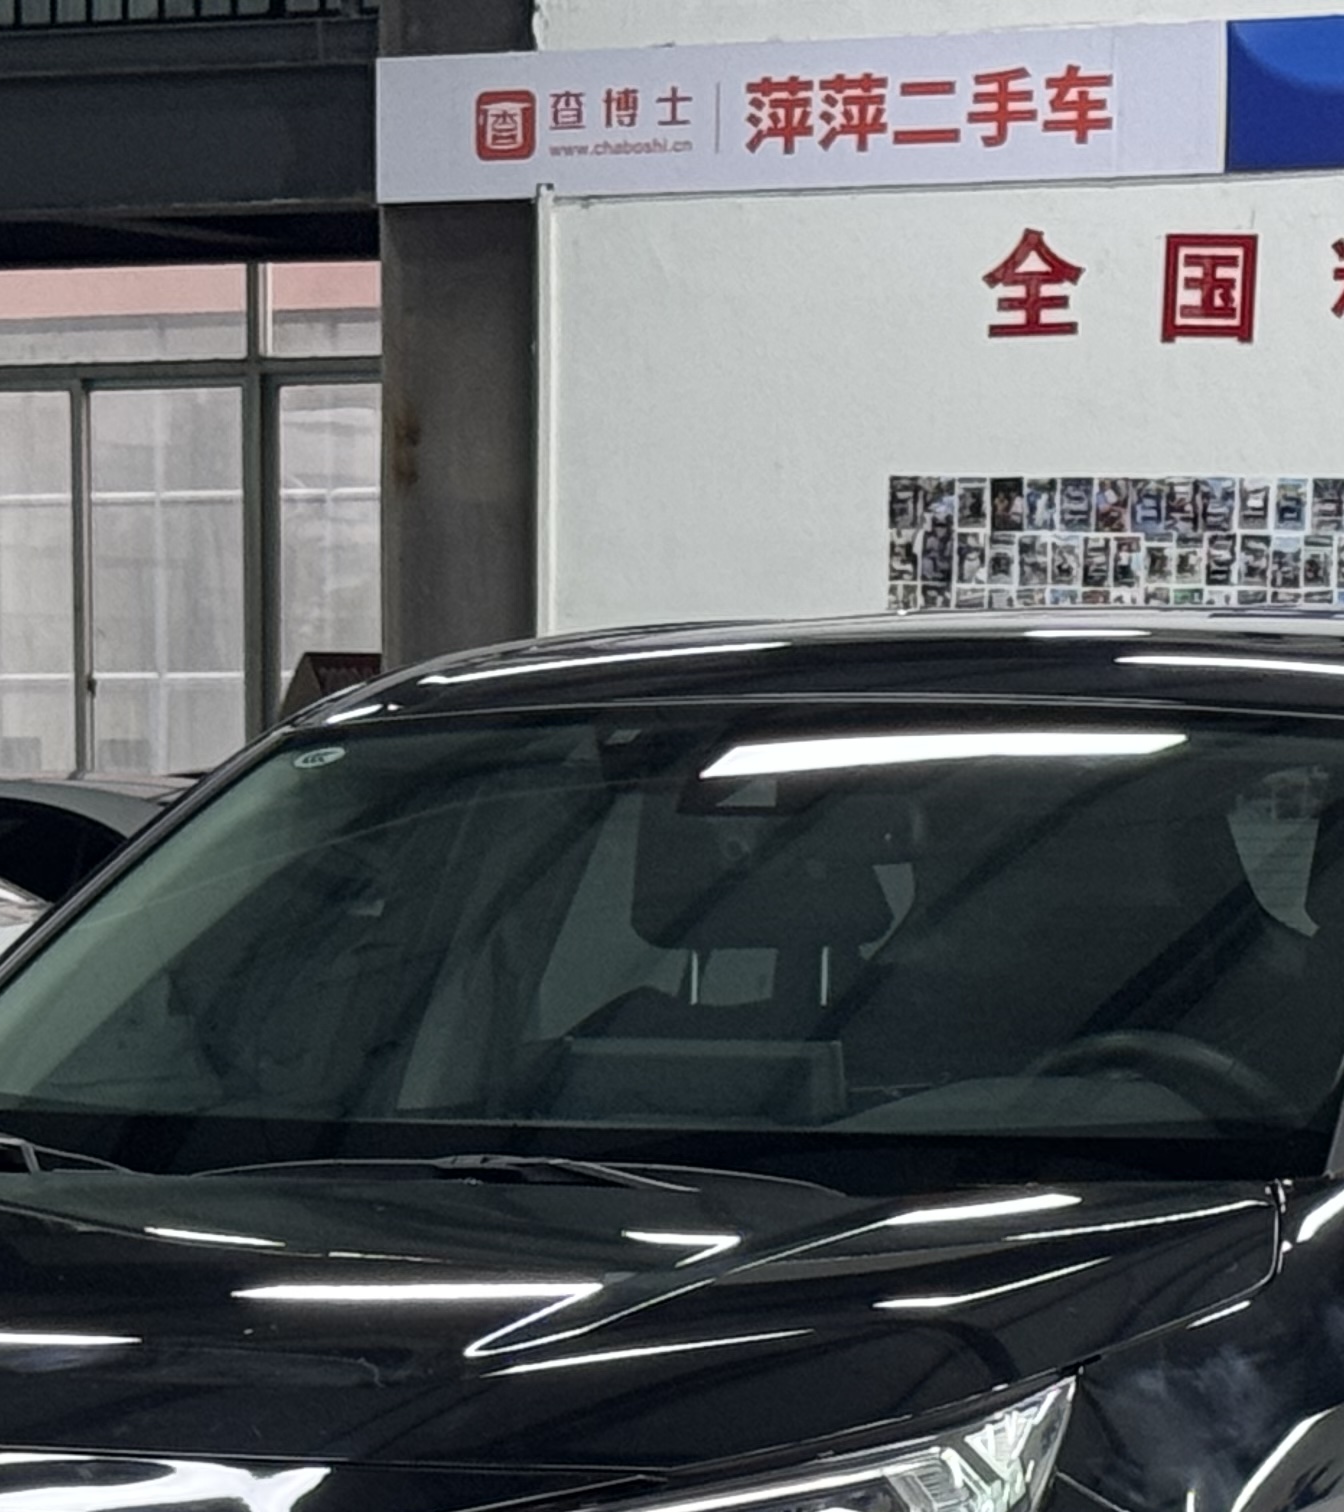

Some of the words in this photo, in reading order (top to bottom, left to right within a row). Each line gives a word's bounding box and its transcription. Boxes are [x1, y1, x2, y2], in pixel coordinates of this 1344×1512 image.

[548, 86, 694, 131] 查博士
[745, 64, 1114, 155] 萍萍二手车
[548, 138, 694, 157] www.chaboshi.cn
